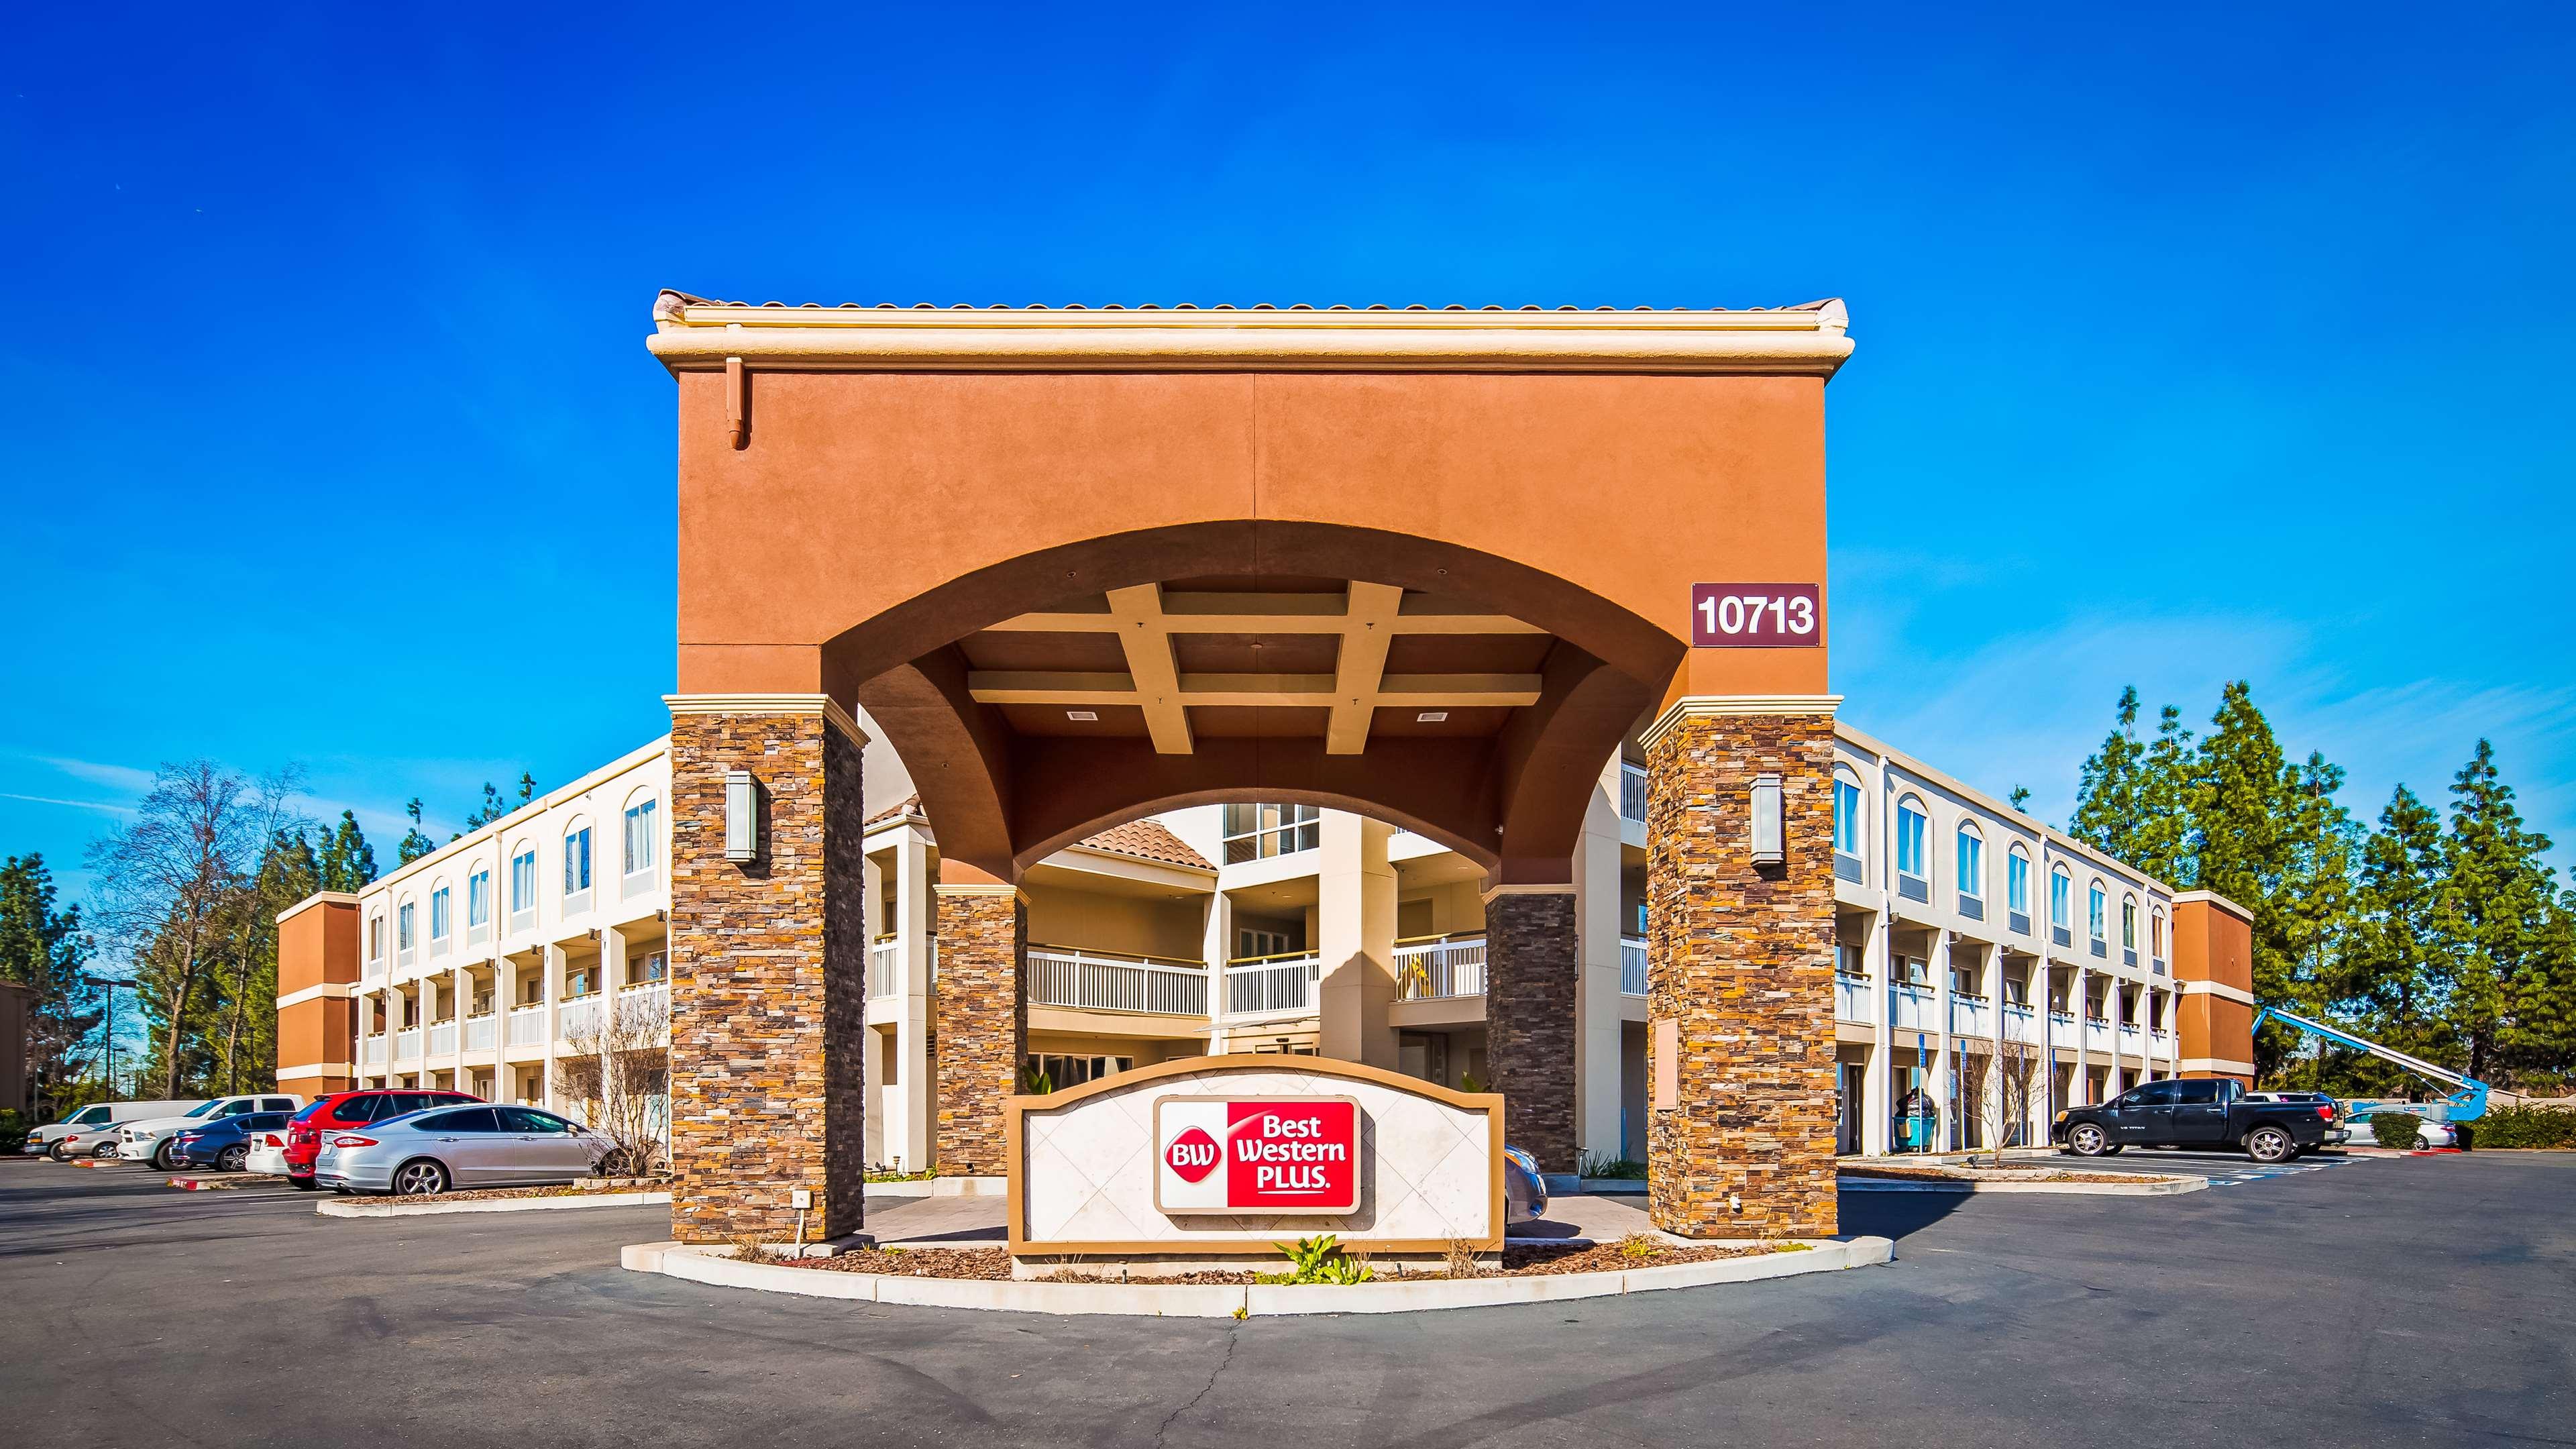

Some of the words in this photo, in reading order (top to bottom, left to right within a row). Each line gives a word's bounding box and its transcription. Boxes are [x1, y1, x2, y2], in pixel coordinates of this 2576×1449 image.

[1697, 595, 1815, 635] 10713
[1263, 1115, 1322, 1138] Best
[1172, 1143, 1215, 1166] BW
[1236, 1138, 1346, 1162] Western
